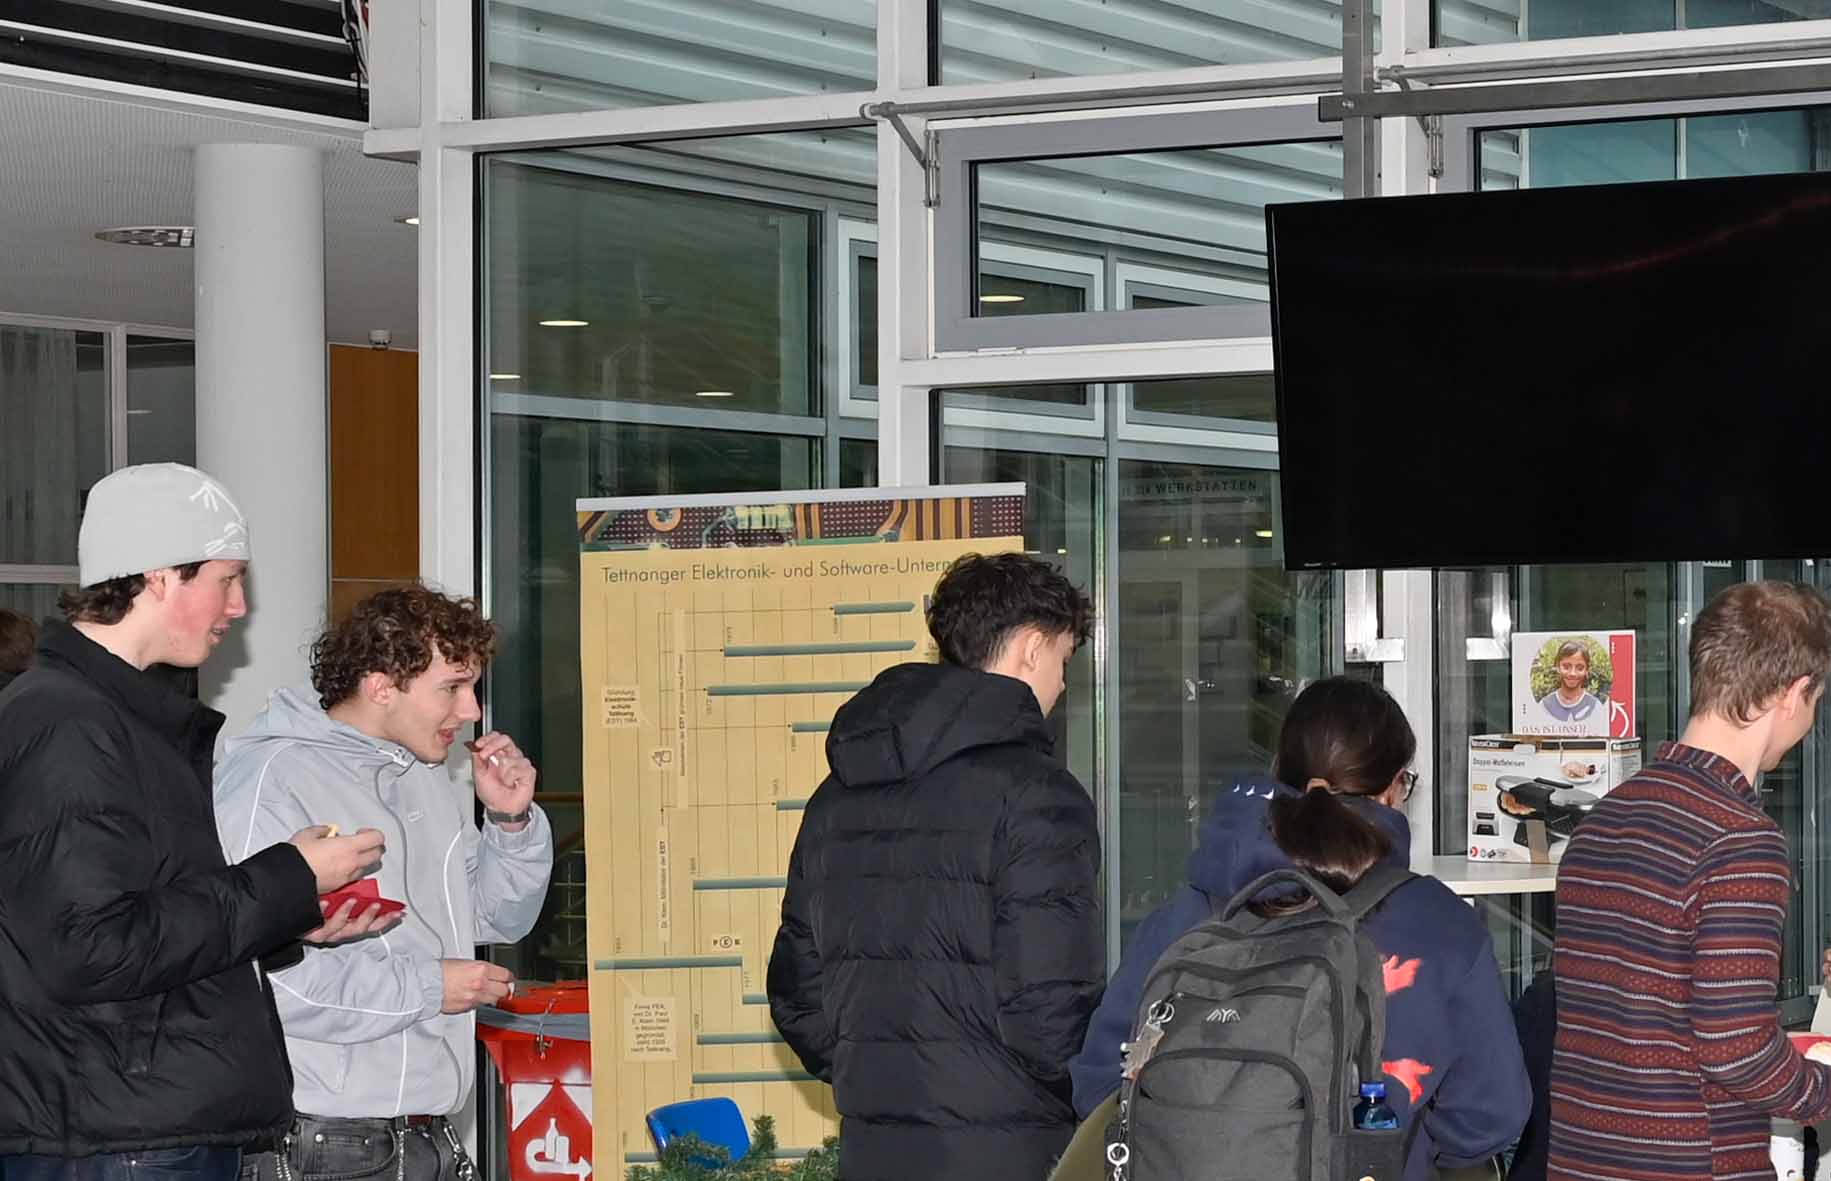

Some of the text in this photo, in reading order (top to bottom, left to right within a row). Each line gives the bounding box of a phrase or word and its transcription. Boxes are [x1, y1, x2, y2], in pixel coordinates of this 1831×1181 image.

[601, 556, 953, 585] Tettnanger Elektronik- und Software-Untern
